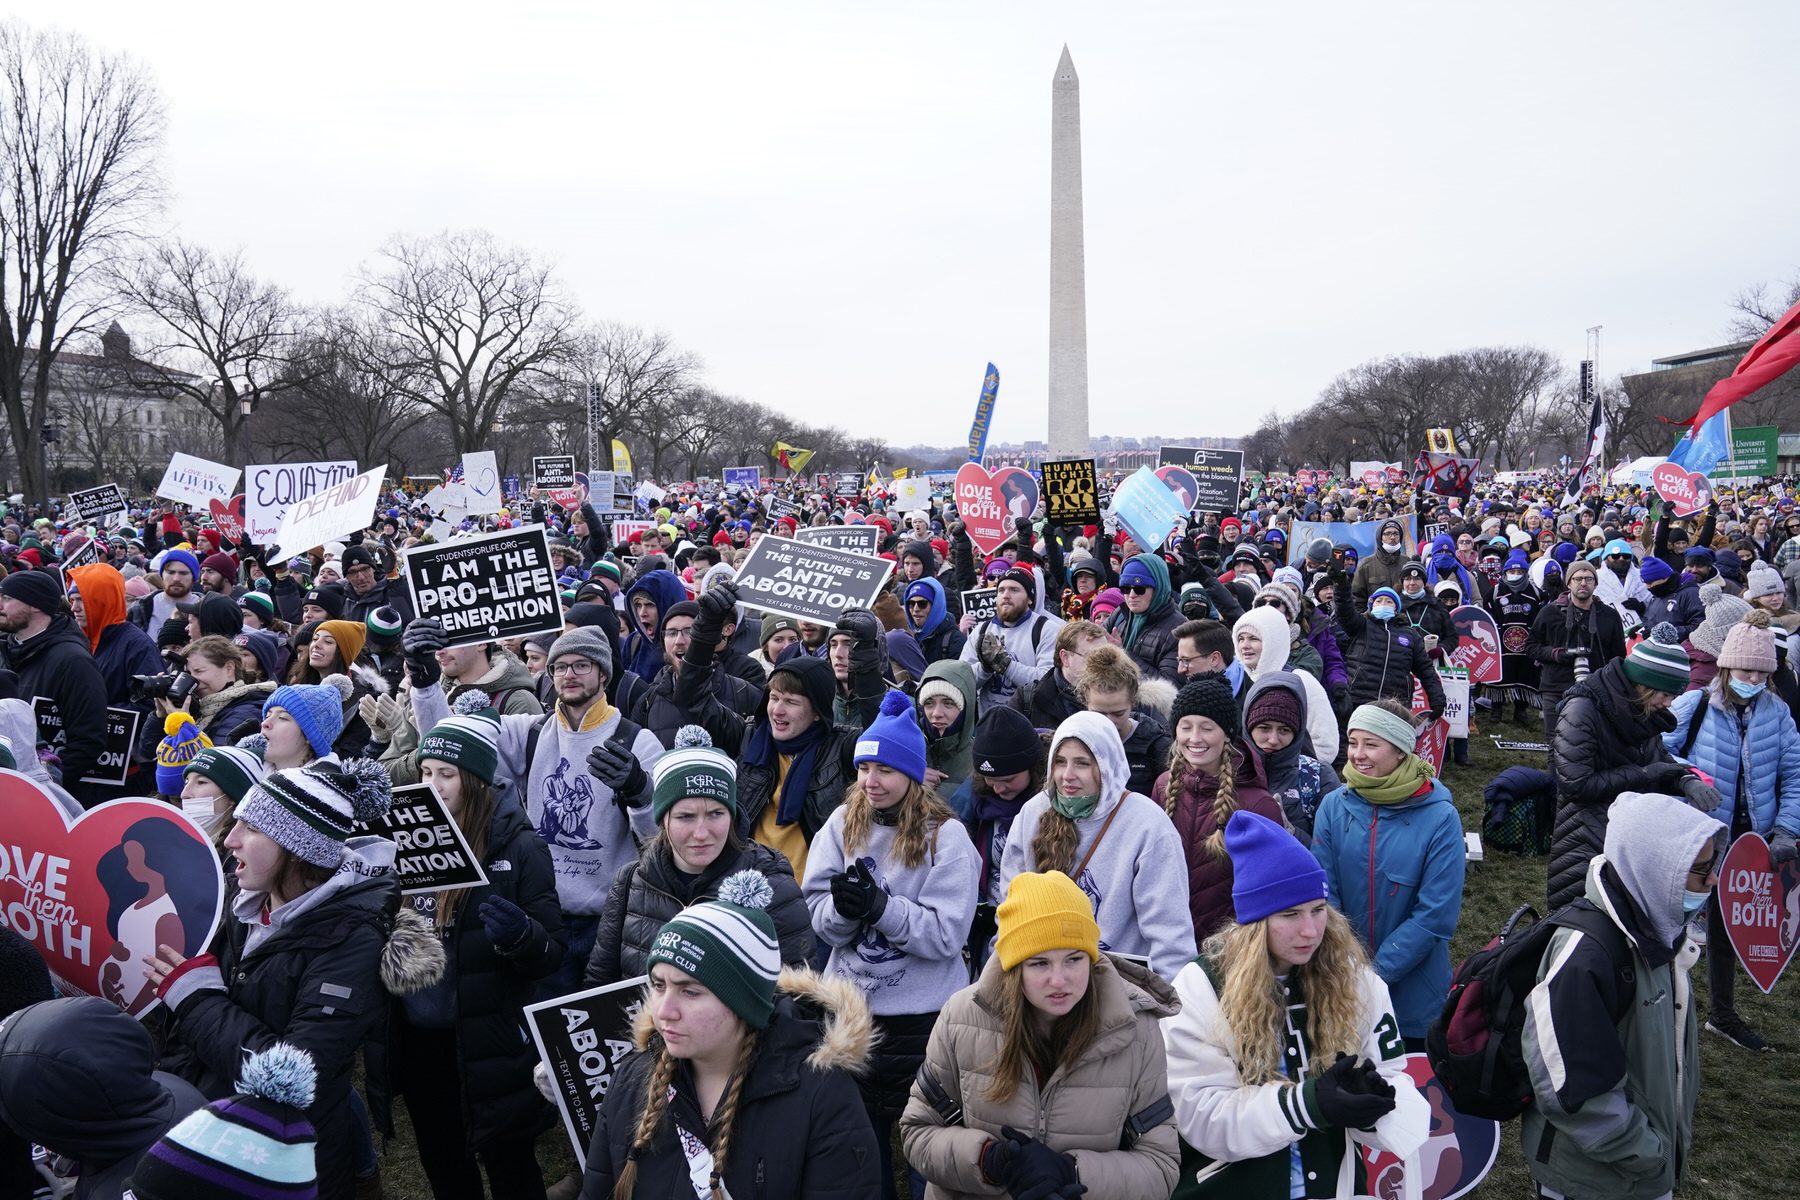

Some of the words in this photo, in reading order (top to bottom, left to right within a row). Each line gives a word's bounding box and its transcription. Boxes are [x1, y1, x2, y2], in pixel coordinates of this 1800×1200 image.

[543, 469, 564, 477] ANTI-
[1044, 462, 1092, 473] HUMAN
[1045, 469, 1093, 480] RIGHTS
[1185, 462, 1210, 472] human
[1210, 465, 1233, 473] weeds
[536, 475, 573, 484] ABORTION
[1201, 472, 1210, 480] the
[1211, 473, 1238, 483] blooming
[1658, 471, 1689, 487] LOVE
[97, 490, 115, 498] THE
[959, 482, 993, 500] LOVE
[1661, 482, 1693, 499] BOTH
[77, 494, 120, 510] POST-ROE
[81, 501, 122, 516] GENERATION
[961, 501, 1001, 520] BOTH
[215, 513, 237, 526] LOVE
[839, 536, 868, 546] THE
[435, 540, 518, 563] STUDENTSFORLIFE.ORG
[789, 545, 869, 567] STUDENTSFORLIFE.ORG
[420, 568, 430, 585] I
[441, 558, 480, 582] AM
[488, 547, 539, 572] THE
[765, 550, 794, 564] THE
[796, 557, 854, 577] FUTURE
[856, 569, 872, 581] IS
[774, 565, 843, 589] ANTI-
[418, 567, 552, 613] PRO-LIFE
[737, 574, 865, 609] ABORTION
[765, 597, 779, 606] TEXT
[779, 600, 792, 609] LIFE
[801, 606, 820, 616] 53445
[969, 600, 974, 609] I
[40, 714, 62, 727] THE
[113, 724, 125, 735] IS
[444, 751, 459, 759] CLUB
[686, 788, 716, 796] PRO-LIFE
[563, 855, 603, 870] University
[563, 866, 582, 879] Life
[1728, 868, 1774, 895] LOVE
[5, 875, 79, 926] them
[1731, 902, 1778, 928] BOTH
[0, 901, 92, 967] OTH
[1749, 944, 1761, 957] LIVE
[675, 955, 697, 972] CLUB
[1373, 1012, 1405, 1062] 2
[559, 1060, 569, 1079] TEXT
[565, 1078, 577, 1097] LIFE
[571, 1096, 582, 1108] TO
[576, 1107, 590, 1132] 53445
